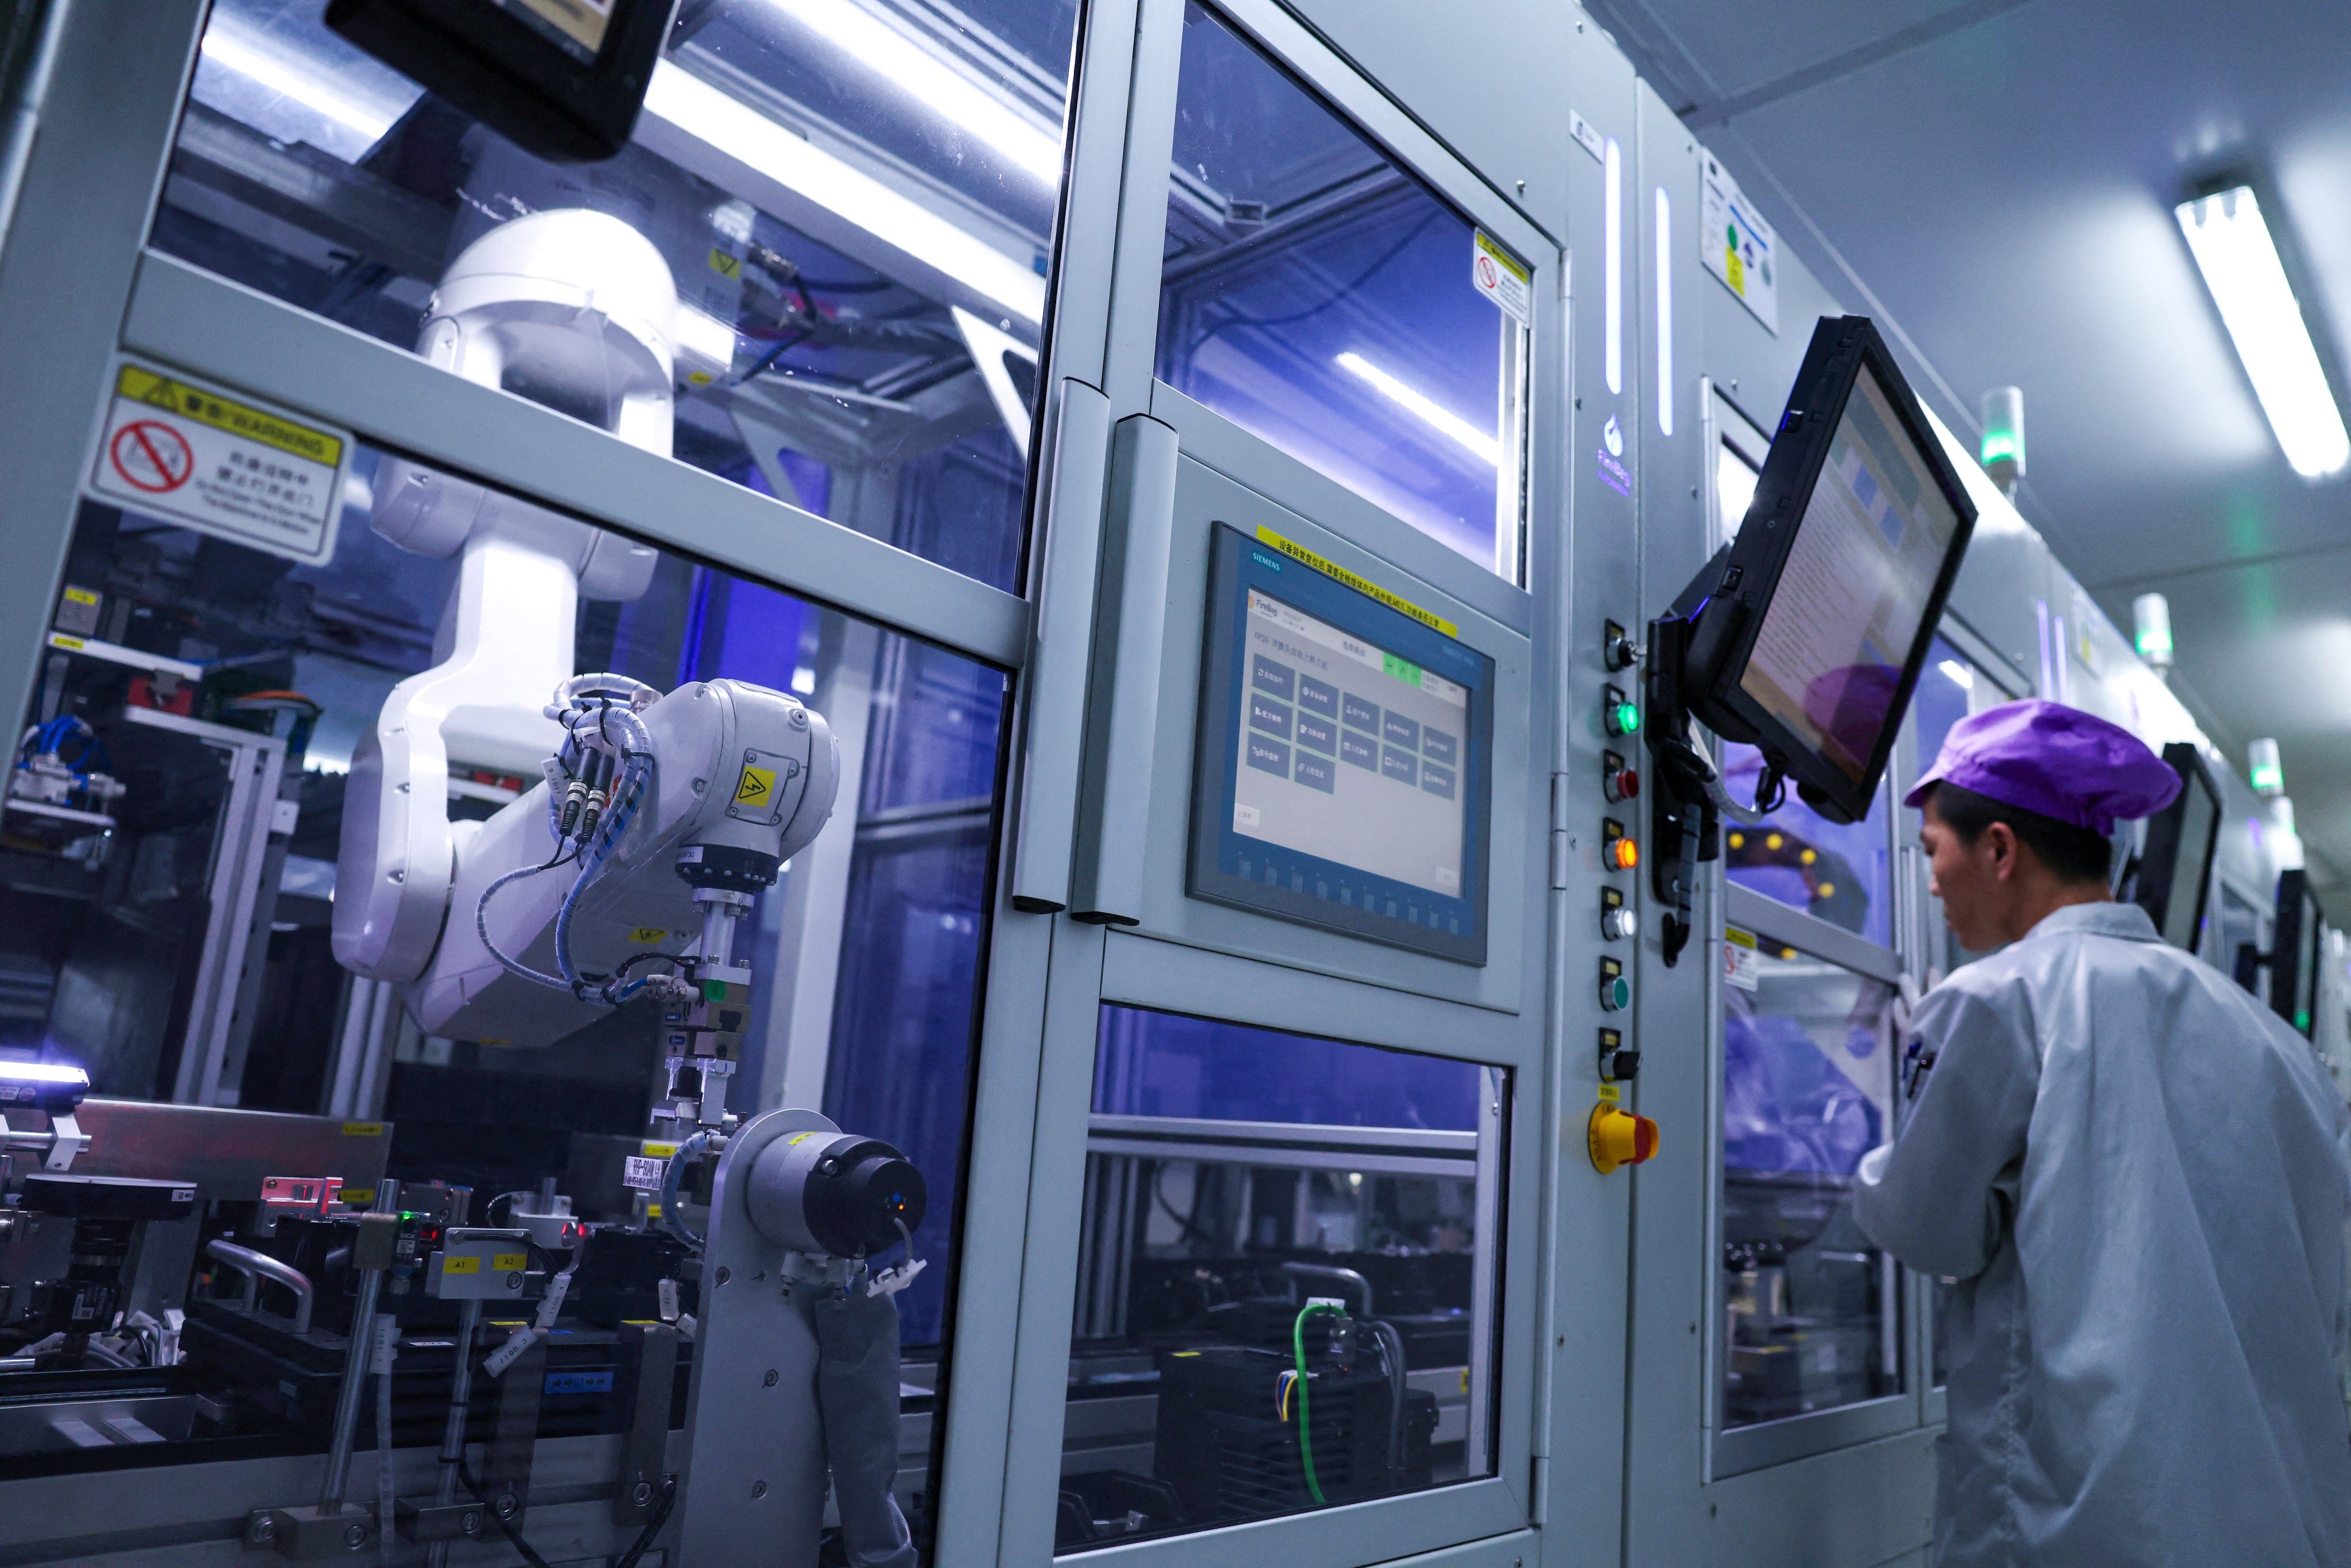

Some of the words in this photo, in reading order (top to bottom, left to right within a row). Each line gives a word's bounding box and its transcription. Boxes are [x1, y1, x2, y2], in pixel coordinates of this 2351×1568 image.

[1253, 552, 1280, 571] SIEMENS
[1256, 599, 1278, 616] FireBag
[573, 1377, 584, 1387] 01
